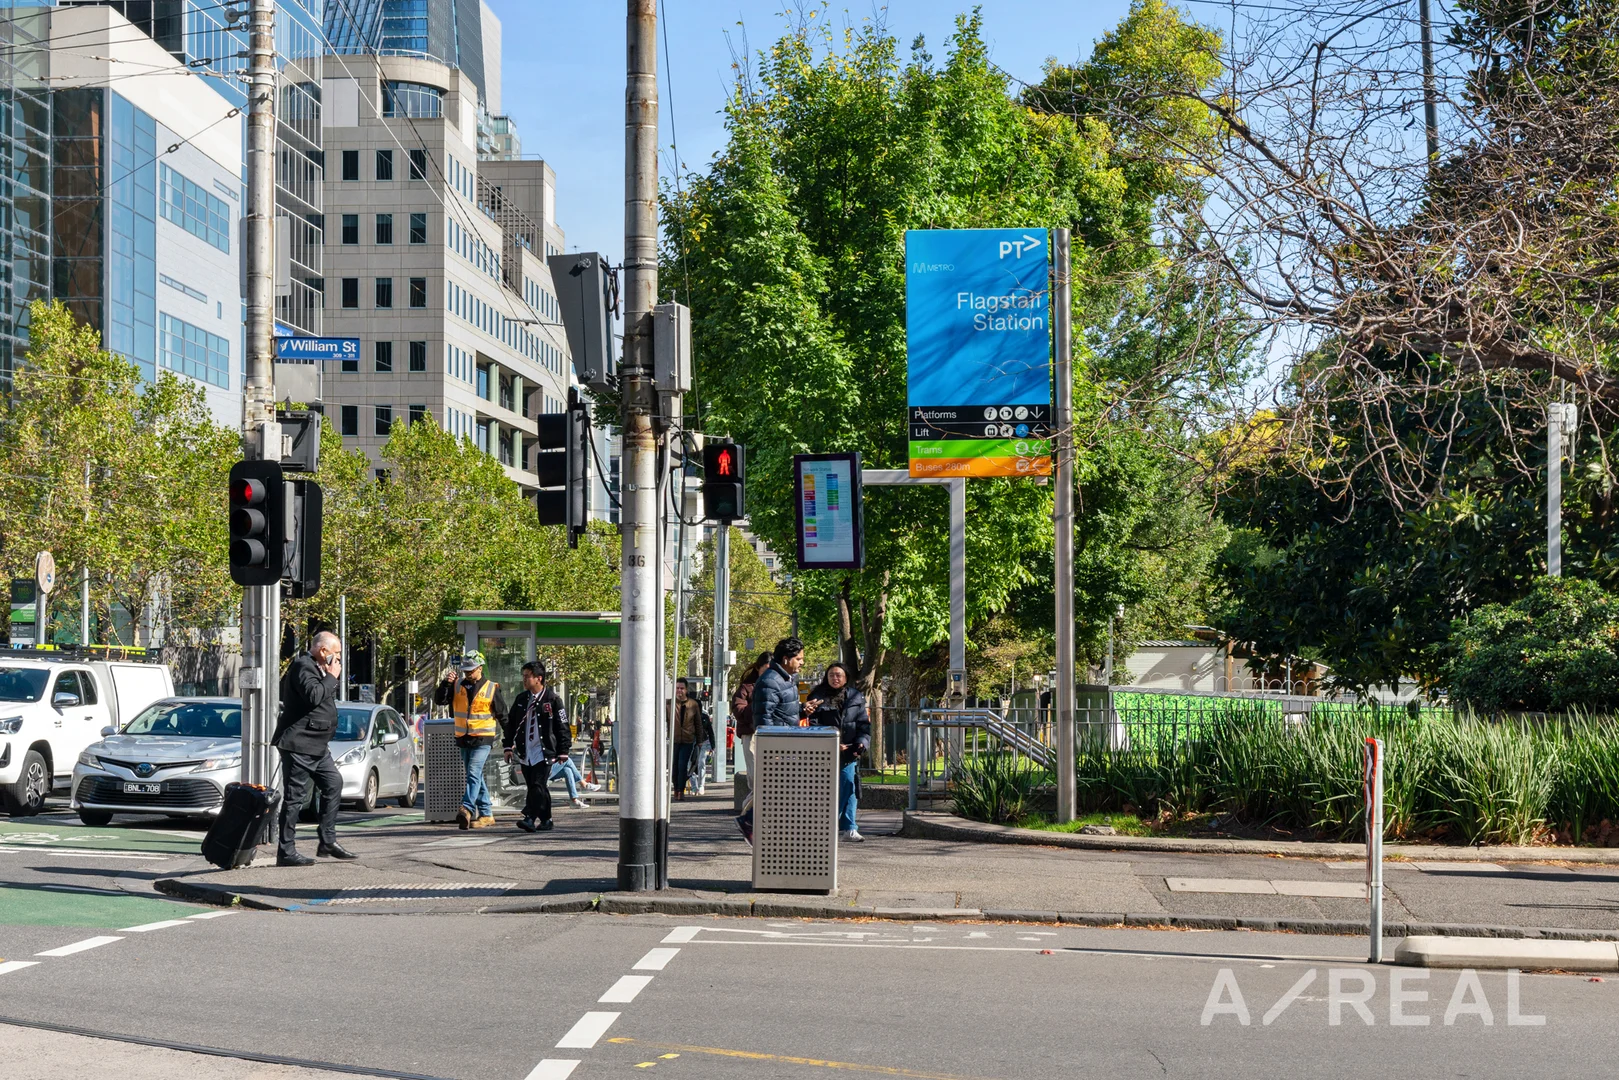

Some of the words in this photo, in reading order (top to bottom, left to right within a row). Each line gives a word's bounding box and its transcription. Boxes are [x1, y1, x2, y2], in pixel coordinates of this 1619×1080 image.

[927, 263, 955, 272] METRO
[973, 313, 1043, 331] Station
[290, 340, 337, 352] William
[343, 342, 357, 353] St
[914, 410, 957, 419] Platforms
[915, 428, 930, 437] Lift
[915, 445, 943, 454] Trams
[915, 463, 943, 472] Buses
[945, 463, 971, 472] 280m
